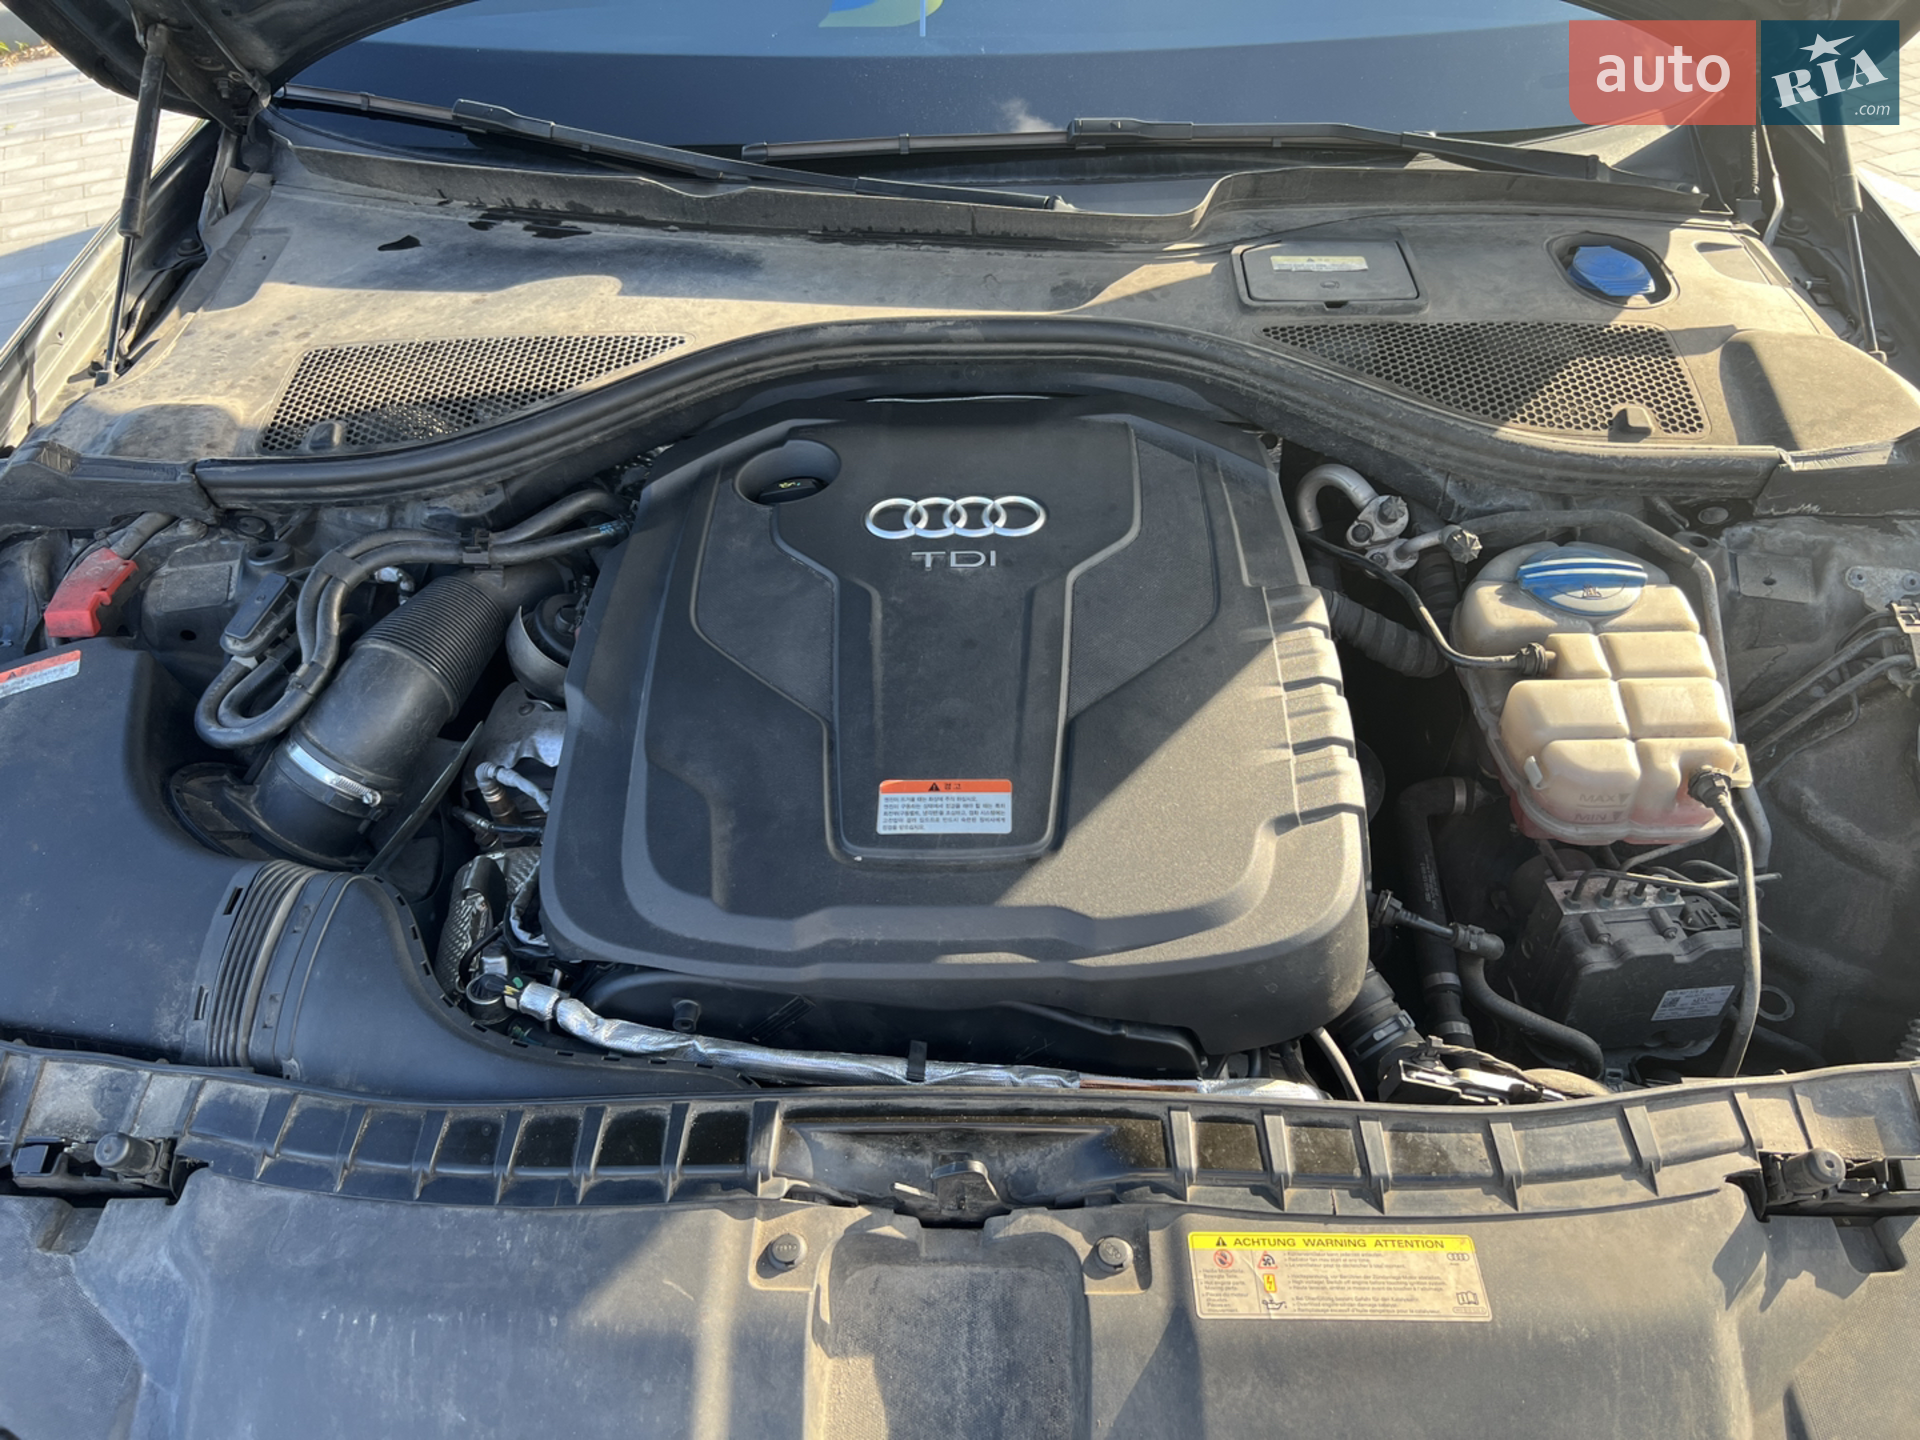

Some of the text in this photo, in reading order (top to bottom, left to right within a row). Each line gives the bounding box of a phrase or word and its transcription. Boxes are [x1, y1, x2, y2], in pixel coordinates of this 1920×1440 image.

[911, 550, 996, 568] TDI
[1579, 793, 1616, 803] MAX
[1575, 812, 1608, 821] MIN
[1233, 1237, 1445, 1249] ACHTUNG WARNING ATTENTION
